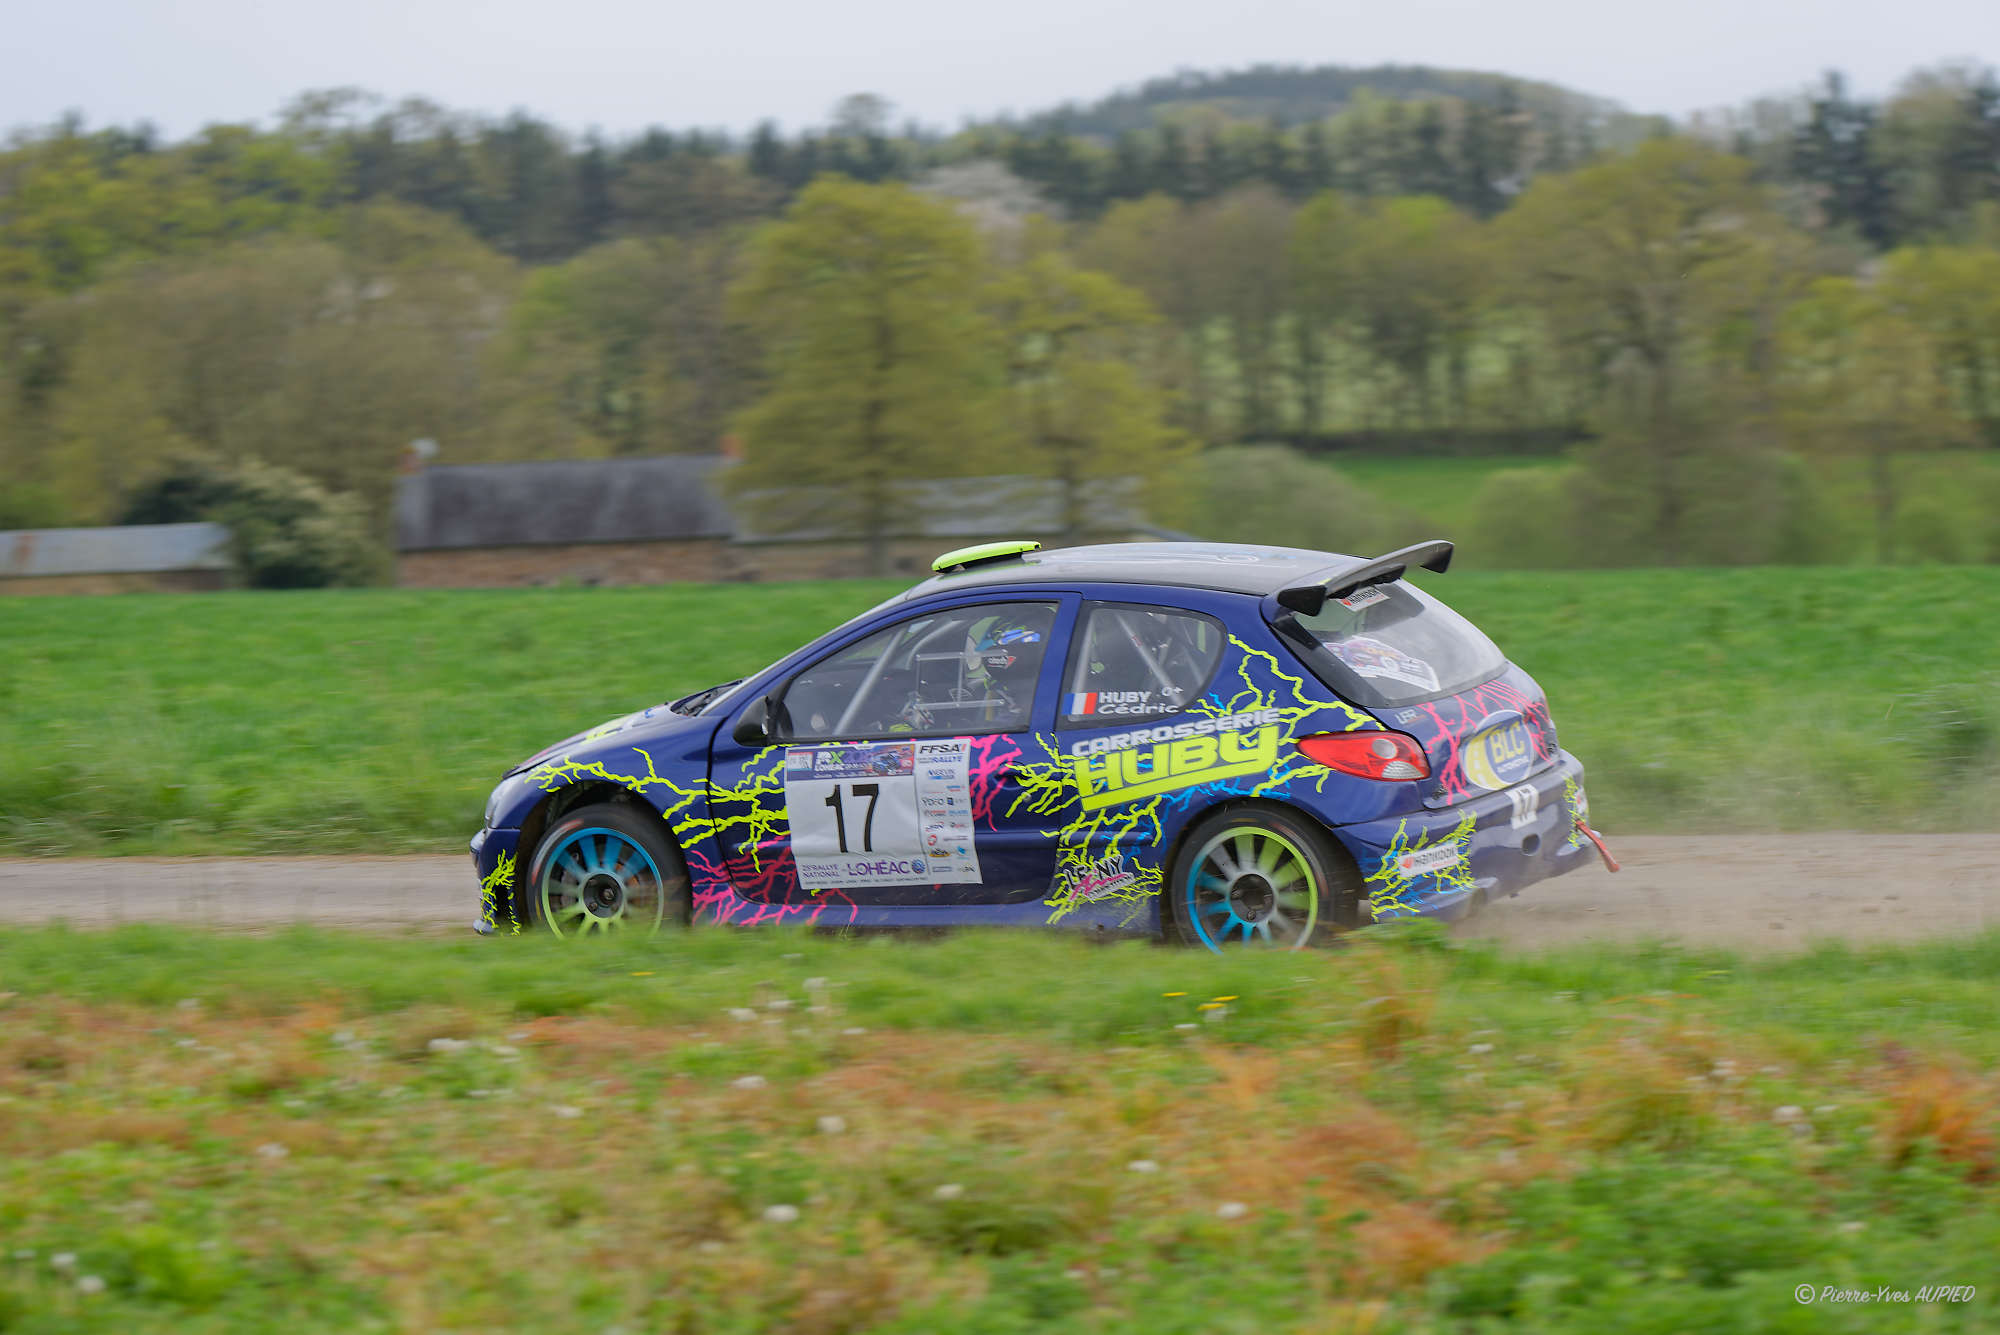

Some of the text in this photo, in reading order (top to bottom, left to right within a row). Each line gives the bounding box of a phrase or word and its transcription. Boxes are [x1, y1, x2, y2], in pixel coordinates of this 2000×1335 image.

[1098, 691, 1151, 703] HUBY
[1098, 702, 1179, 714] Cédric
[1072, 708, 1280, 757] CARROSSERIE
[919, 744, 960, 754] FFSA
[1489, 720, 1526, 764] BLC
[1074, 725, 1279, 798] HUBY
[825, 783, 880, 854] 17
[802, 871, 840, 879] NATIONAL
[847, 860, 910, 877] LOHÉAC
